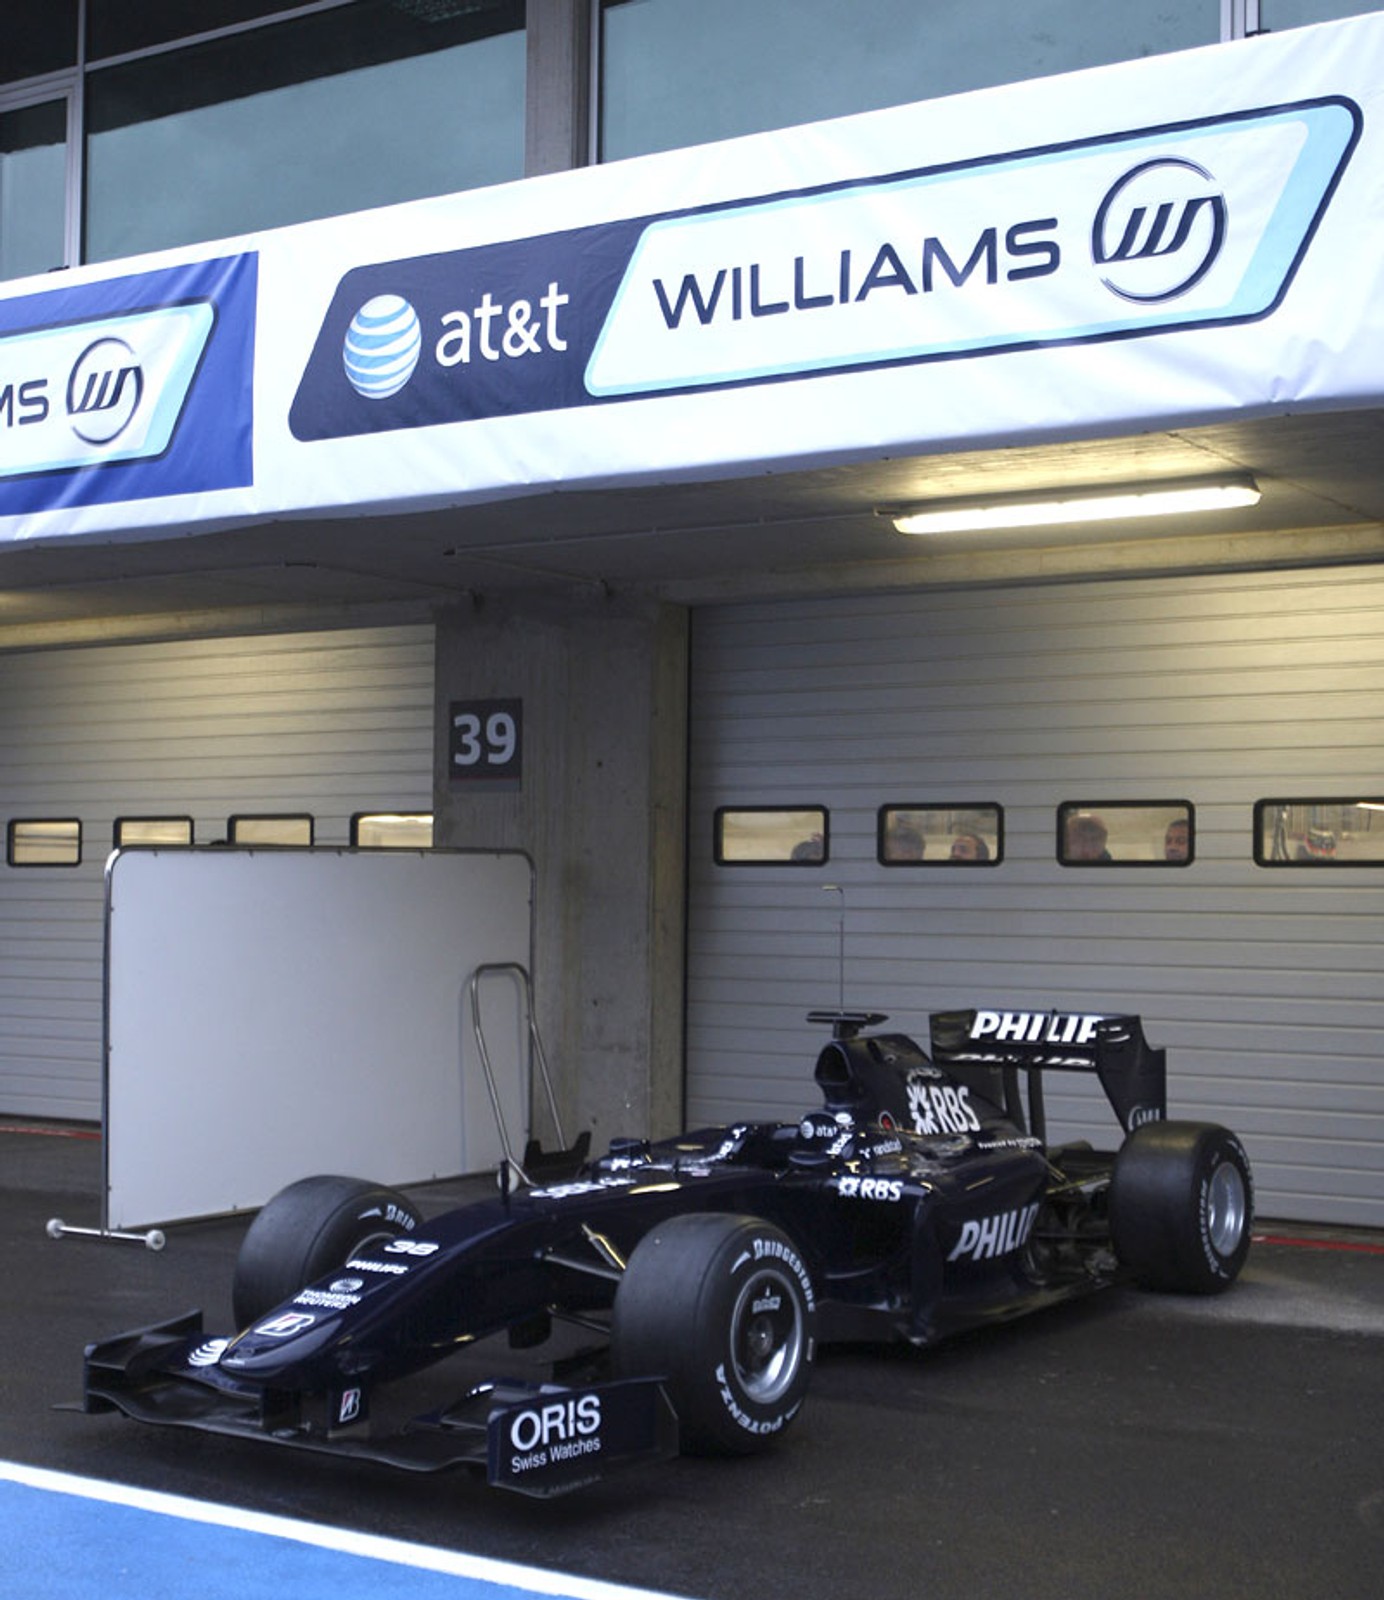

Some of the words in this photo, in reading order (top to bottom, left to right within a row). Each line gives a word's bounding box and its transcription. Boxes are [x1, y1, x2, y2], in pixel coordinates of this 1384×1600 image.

[652, 217, 1061, 331] WILLIAMS
[436, 282, 569, 366] at&t
[453, 711, 516, 766] 39
[969, 1011, 1104, 1043] PHILIP
[928, 1085, 981, 1134] RBS
[860, 1177, 904, 1201] RBS
[385, 1203, 416, 1232] BRID
[510, 1394, 601, 1452] ORIS
[511, 1451, 547, 1474] Swiss
[549, 1436, 602, 1463] Watches
